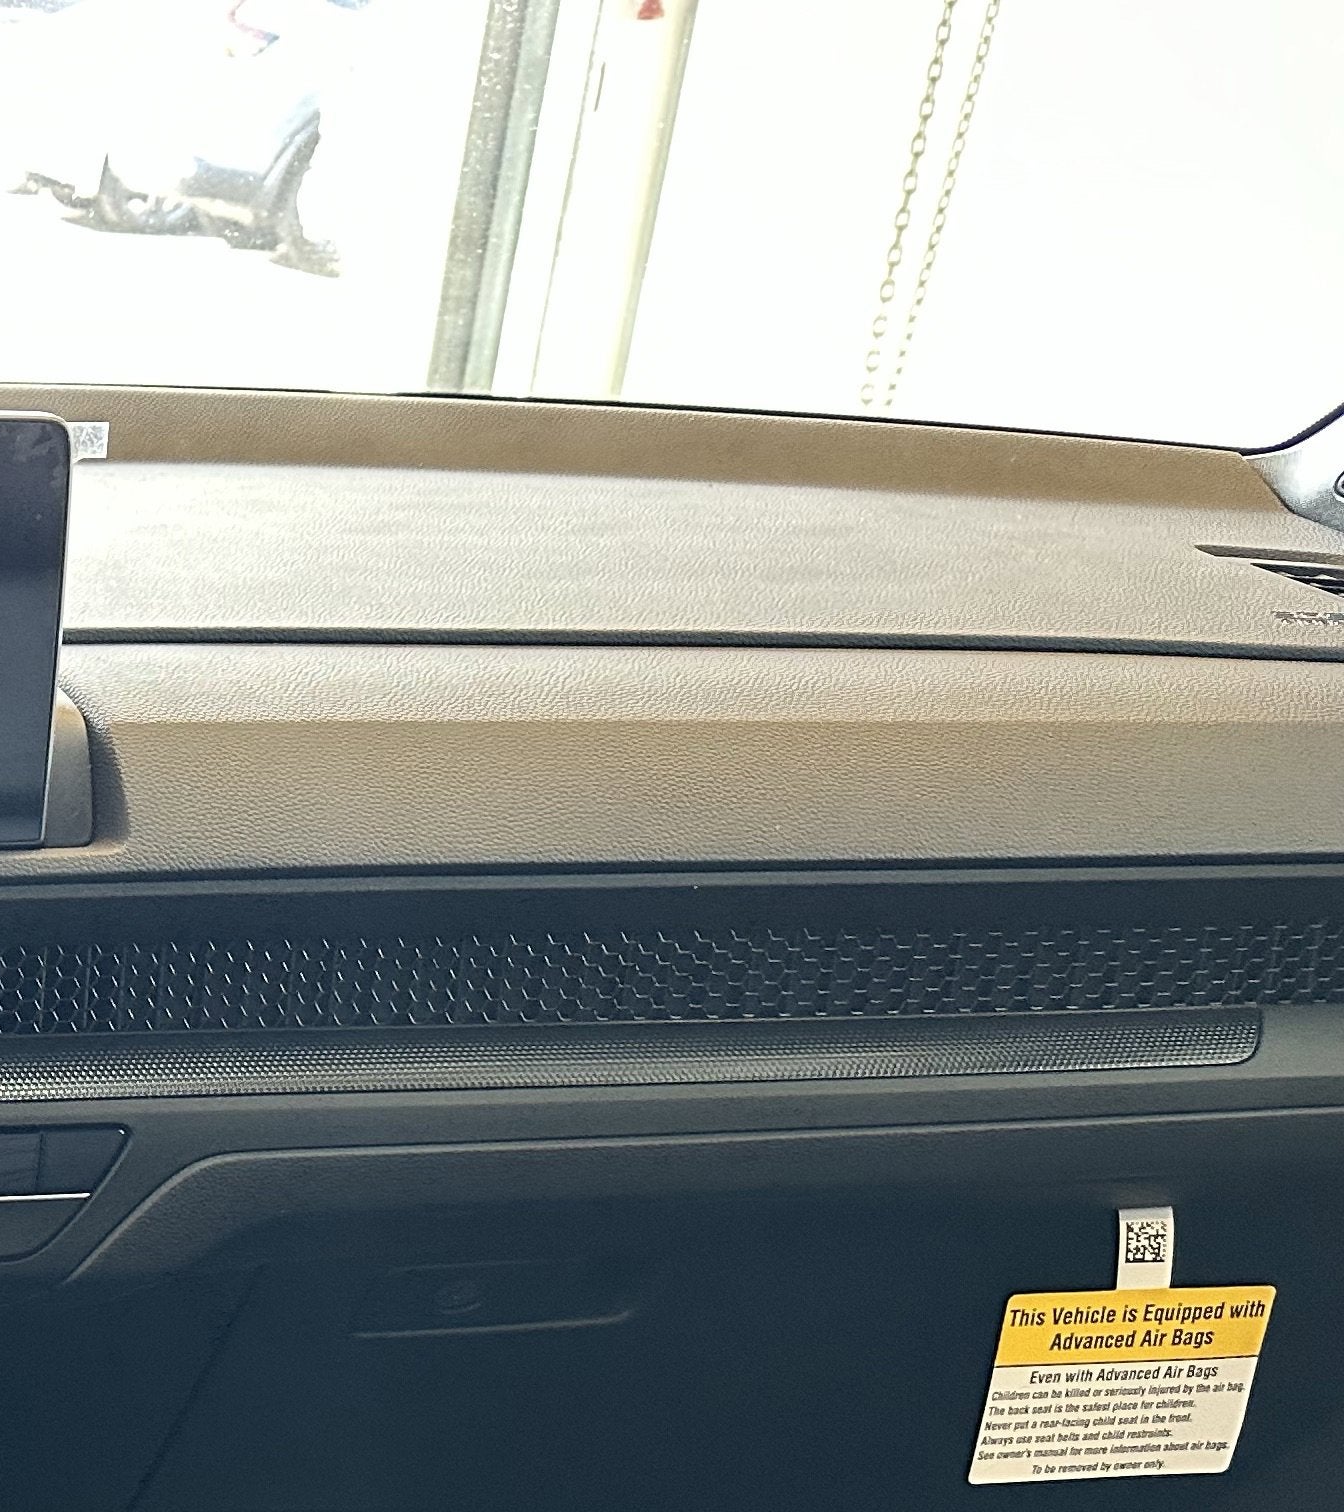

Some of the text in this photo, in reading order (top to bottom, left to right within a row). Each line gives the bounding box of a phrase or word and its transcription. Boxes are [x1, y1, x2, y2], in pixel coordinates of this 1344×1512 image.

[1010, 1300, 1266, 1327] This Vehicle is Equipped with
[1049, 1328, 1215, 1351] Advanced Air Bags
[1029, 1365, 1219, 1385] Even with Advanced Air Bags
[992, 1390, 1030, 1401] Children
[1032, 1391, 1048, 1399] can
[1051, 1389, 1062, 1398] be
[1065, 1388, 1091, 1398] killed
[1093, 1388, 1102, 1397] or
[1104, 1386, 1146, 1397] seriously
[1148, 1384, 1181, 1396] injured
[1182, 1384, 1194, 1395] by
[1196, 1383, 1210, 1393] the
[1213, 1382, 1225, 1392] air
[989, 1406, 1005, 1416] The
[1008, 1405, 1030, 1415] back
[1032, 1405, 1052, 1414] seat
[1054, 1404, 1063, 1413] is
[1065, 1403, 1080, 1412] the
[1082, 1402, 1110, 1412] safest
[1112, 1401, 1138, 1413] place
[1140, 1400, 1154, 1409] for
[984, 1421, 1012, 1431] Never
[1014, 1420, 1030, 1432] put
[1039, 1418, 1090, 1428] rear-facing
[1092, 1416, 1116, 1426] child
[1117, 1416, 1138, 1425] seat
[1140, 1415, 1149, 1424] in
[1152, 1414, 1167, 1423] the
[981, 1435, 1014, 1446] Always
[1016, 1435, 1032, 1444] use
[1035, 1433, 1055, 1443] seat
[1057, 1432, 1079, 1442] belts
[1082, 1431, 1100, 1441] and
[1102, 1430, 1125, 1440] child
[977, 1450, 994, 1461] See
[1034, 1447, 1068, 1457] manual
[1069, 1447, 1083, 1456] for
[1084, 1446, 1108, 1455] more
[1109, 1444, 1161, 1454] information
[1163, 1441, 1189, 1451] about
[1190, 1440, 1204, 1450] air
[1032, 1465, 1043, 1475] To
[1044, 1464, 1056, 1474] be
[1058, 1462, 1099, 1473] removed
[1100, 1462, 1112, 1472] by
[1113, 1461, 1142, 1470] owner
